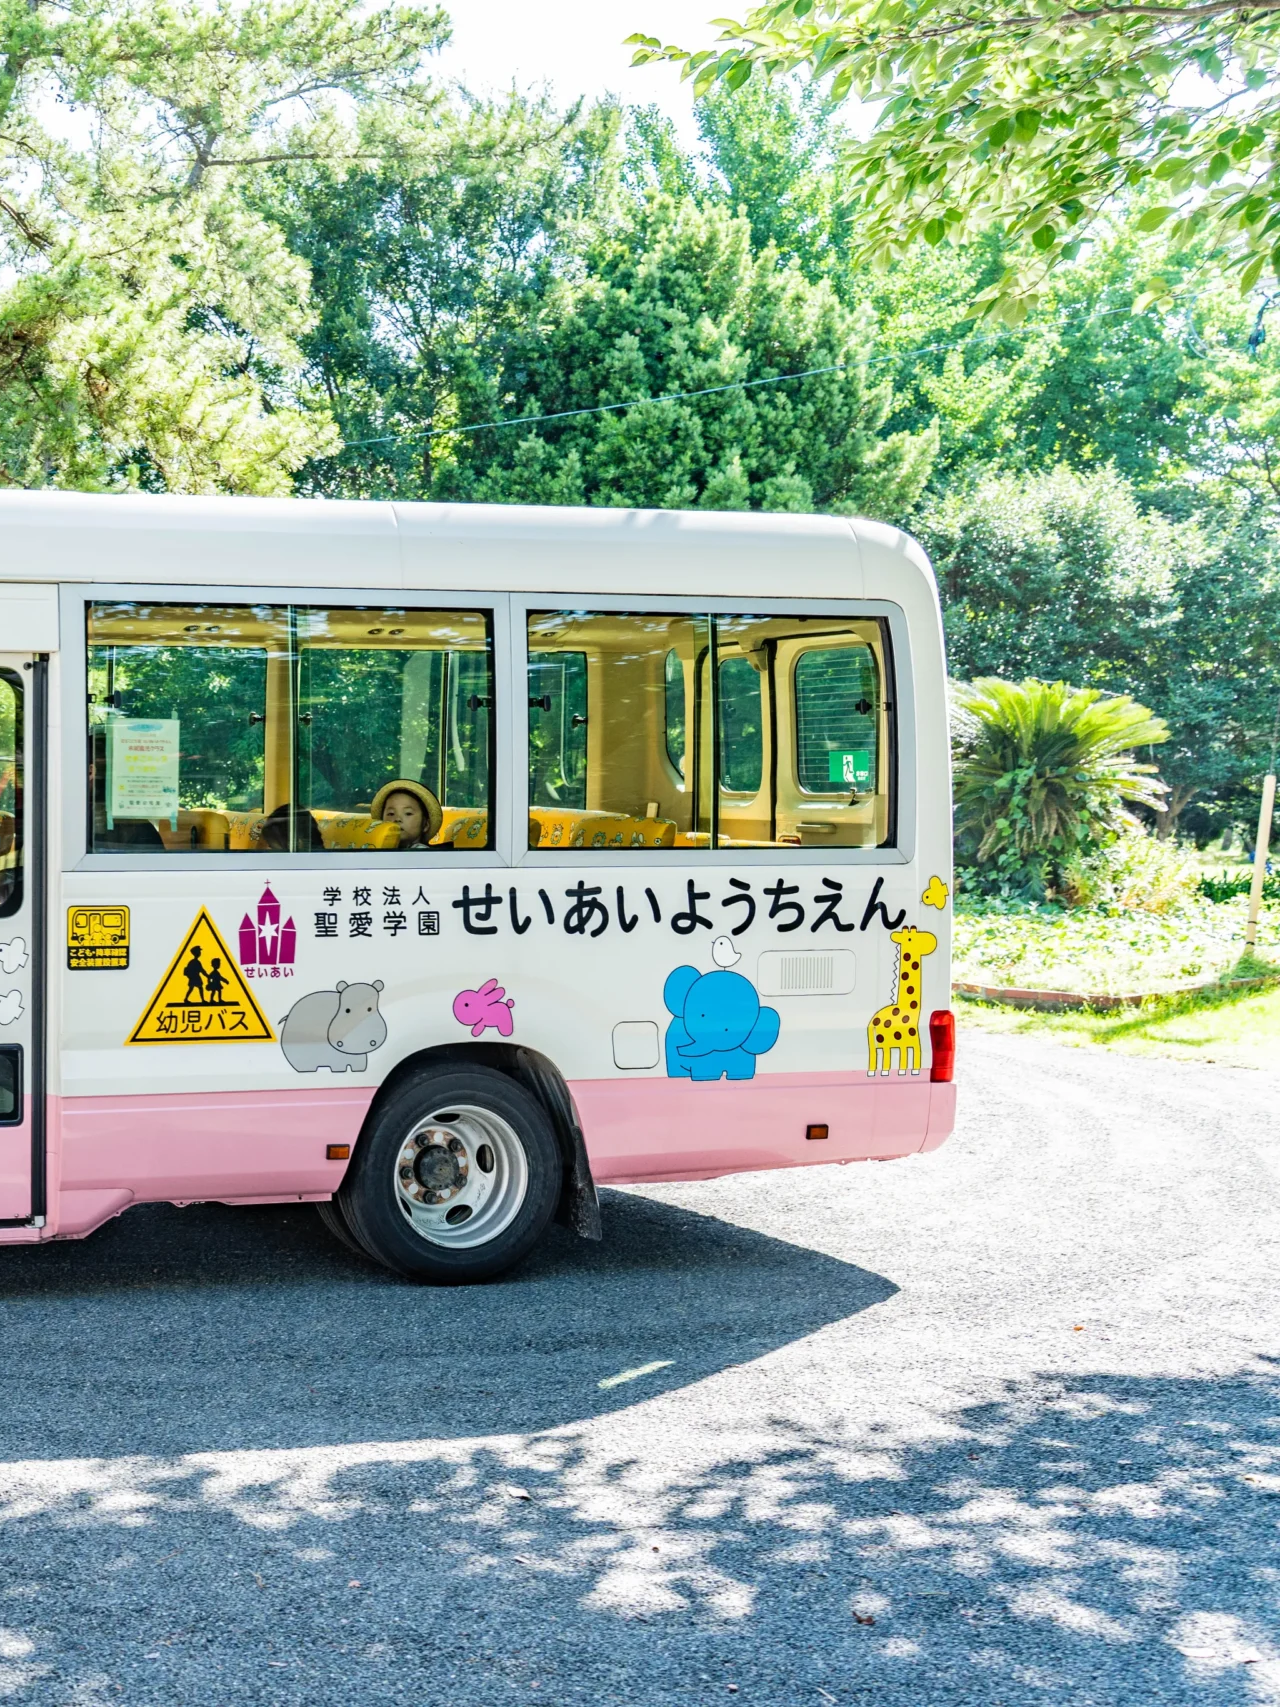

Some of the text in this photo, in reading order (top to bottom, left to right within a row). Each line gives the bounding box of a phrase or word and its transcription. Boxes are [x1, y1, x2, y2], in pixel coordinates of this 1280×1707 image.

[323, 885, 431, 907] 学校法人
[452, 877, 907, 938] せいあいようちえん
[314, 910, 440, 938] 聖愛学園
[244, 966, 294, 979] せいあい
[155, 1008, 249, 1034] 幼児バス
